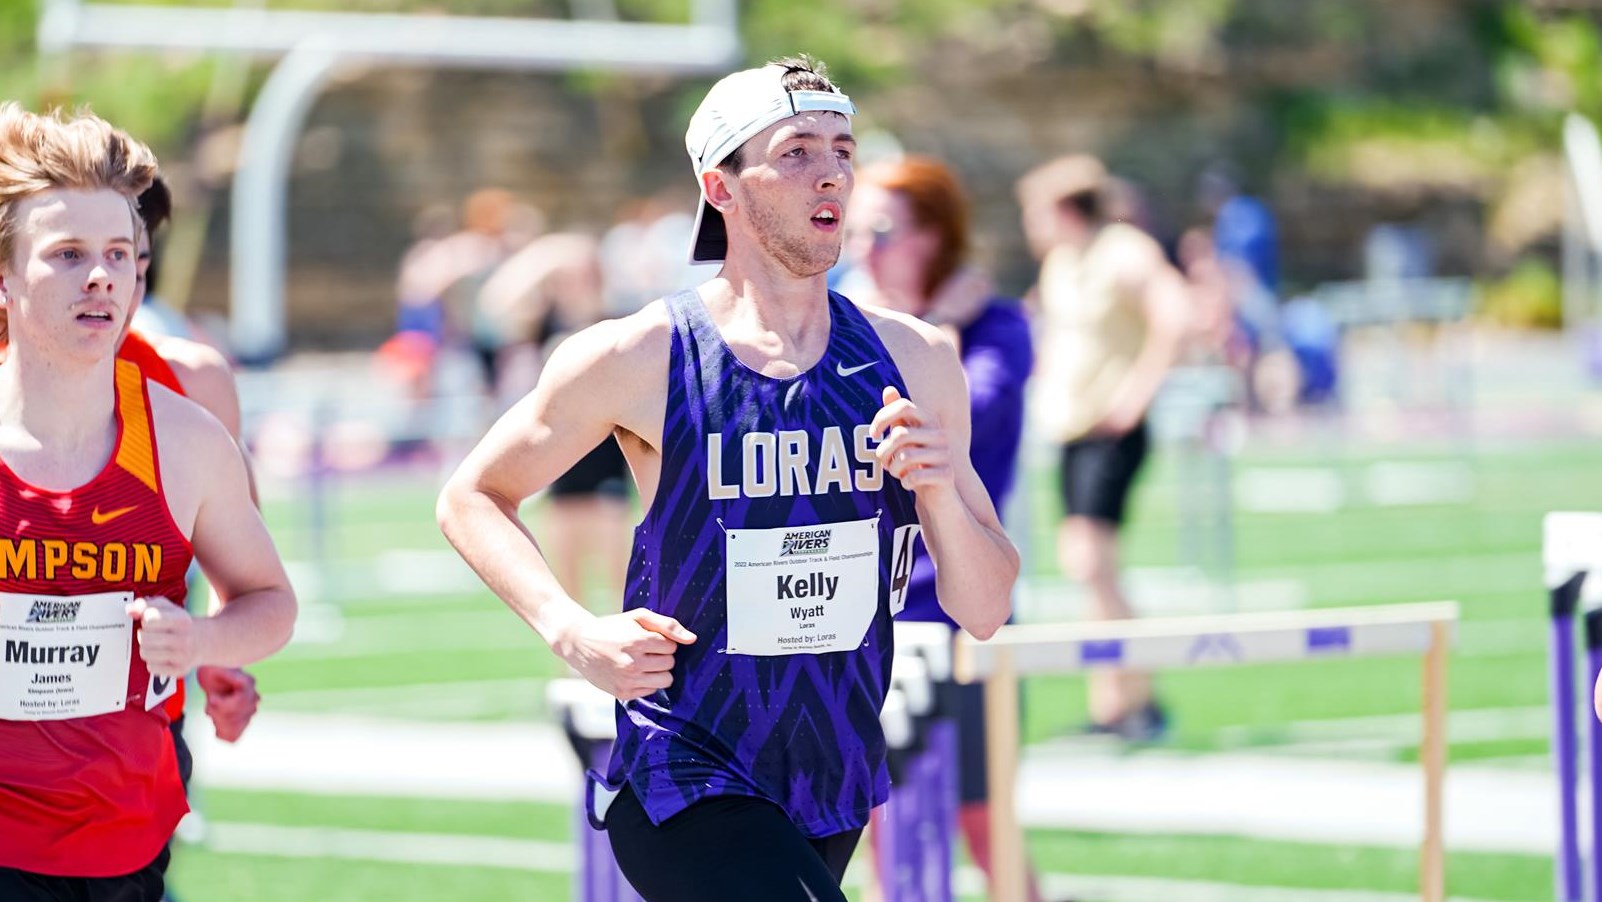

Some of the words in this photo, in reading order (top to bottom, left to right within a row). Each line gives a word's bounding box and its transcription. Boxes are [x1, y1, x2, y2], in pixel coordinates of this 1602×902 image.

[707, 424, 884, 500] LORAS
[784, 529, 831, 540] AMERICAN
[0, 539, 162, 583] MPSON
[748, 560, 772, 568] American
[773, 559, 788, 567] Rivers
[892, 526, 911, 604] 4
[777, 571, 839, 601] Kelly
[32, 600, 81, 609] AMERICAN
[790, 605, 825, 621] Wyatt
[777, 635, 803, 644] Hosted
[804, 635, 816, 644] by:
[817, 632, 837, 642] Loras
[5, 639, 100, 667] Murray
[31, 672, 72, 684] James
[19, 699, 46, 708] Hosted
[60, 698, 81, 707] Loras
